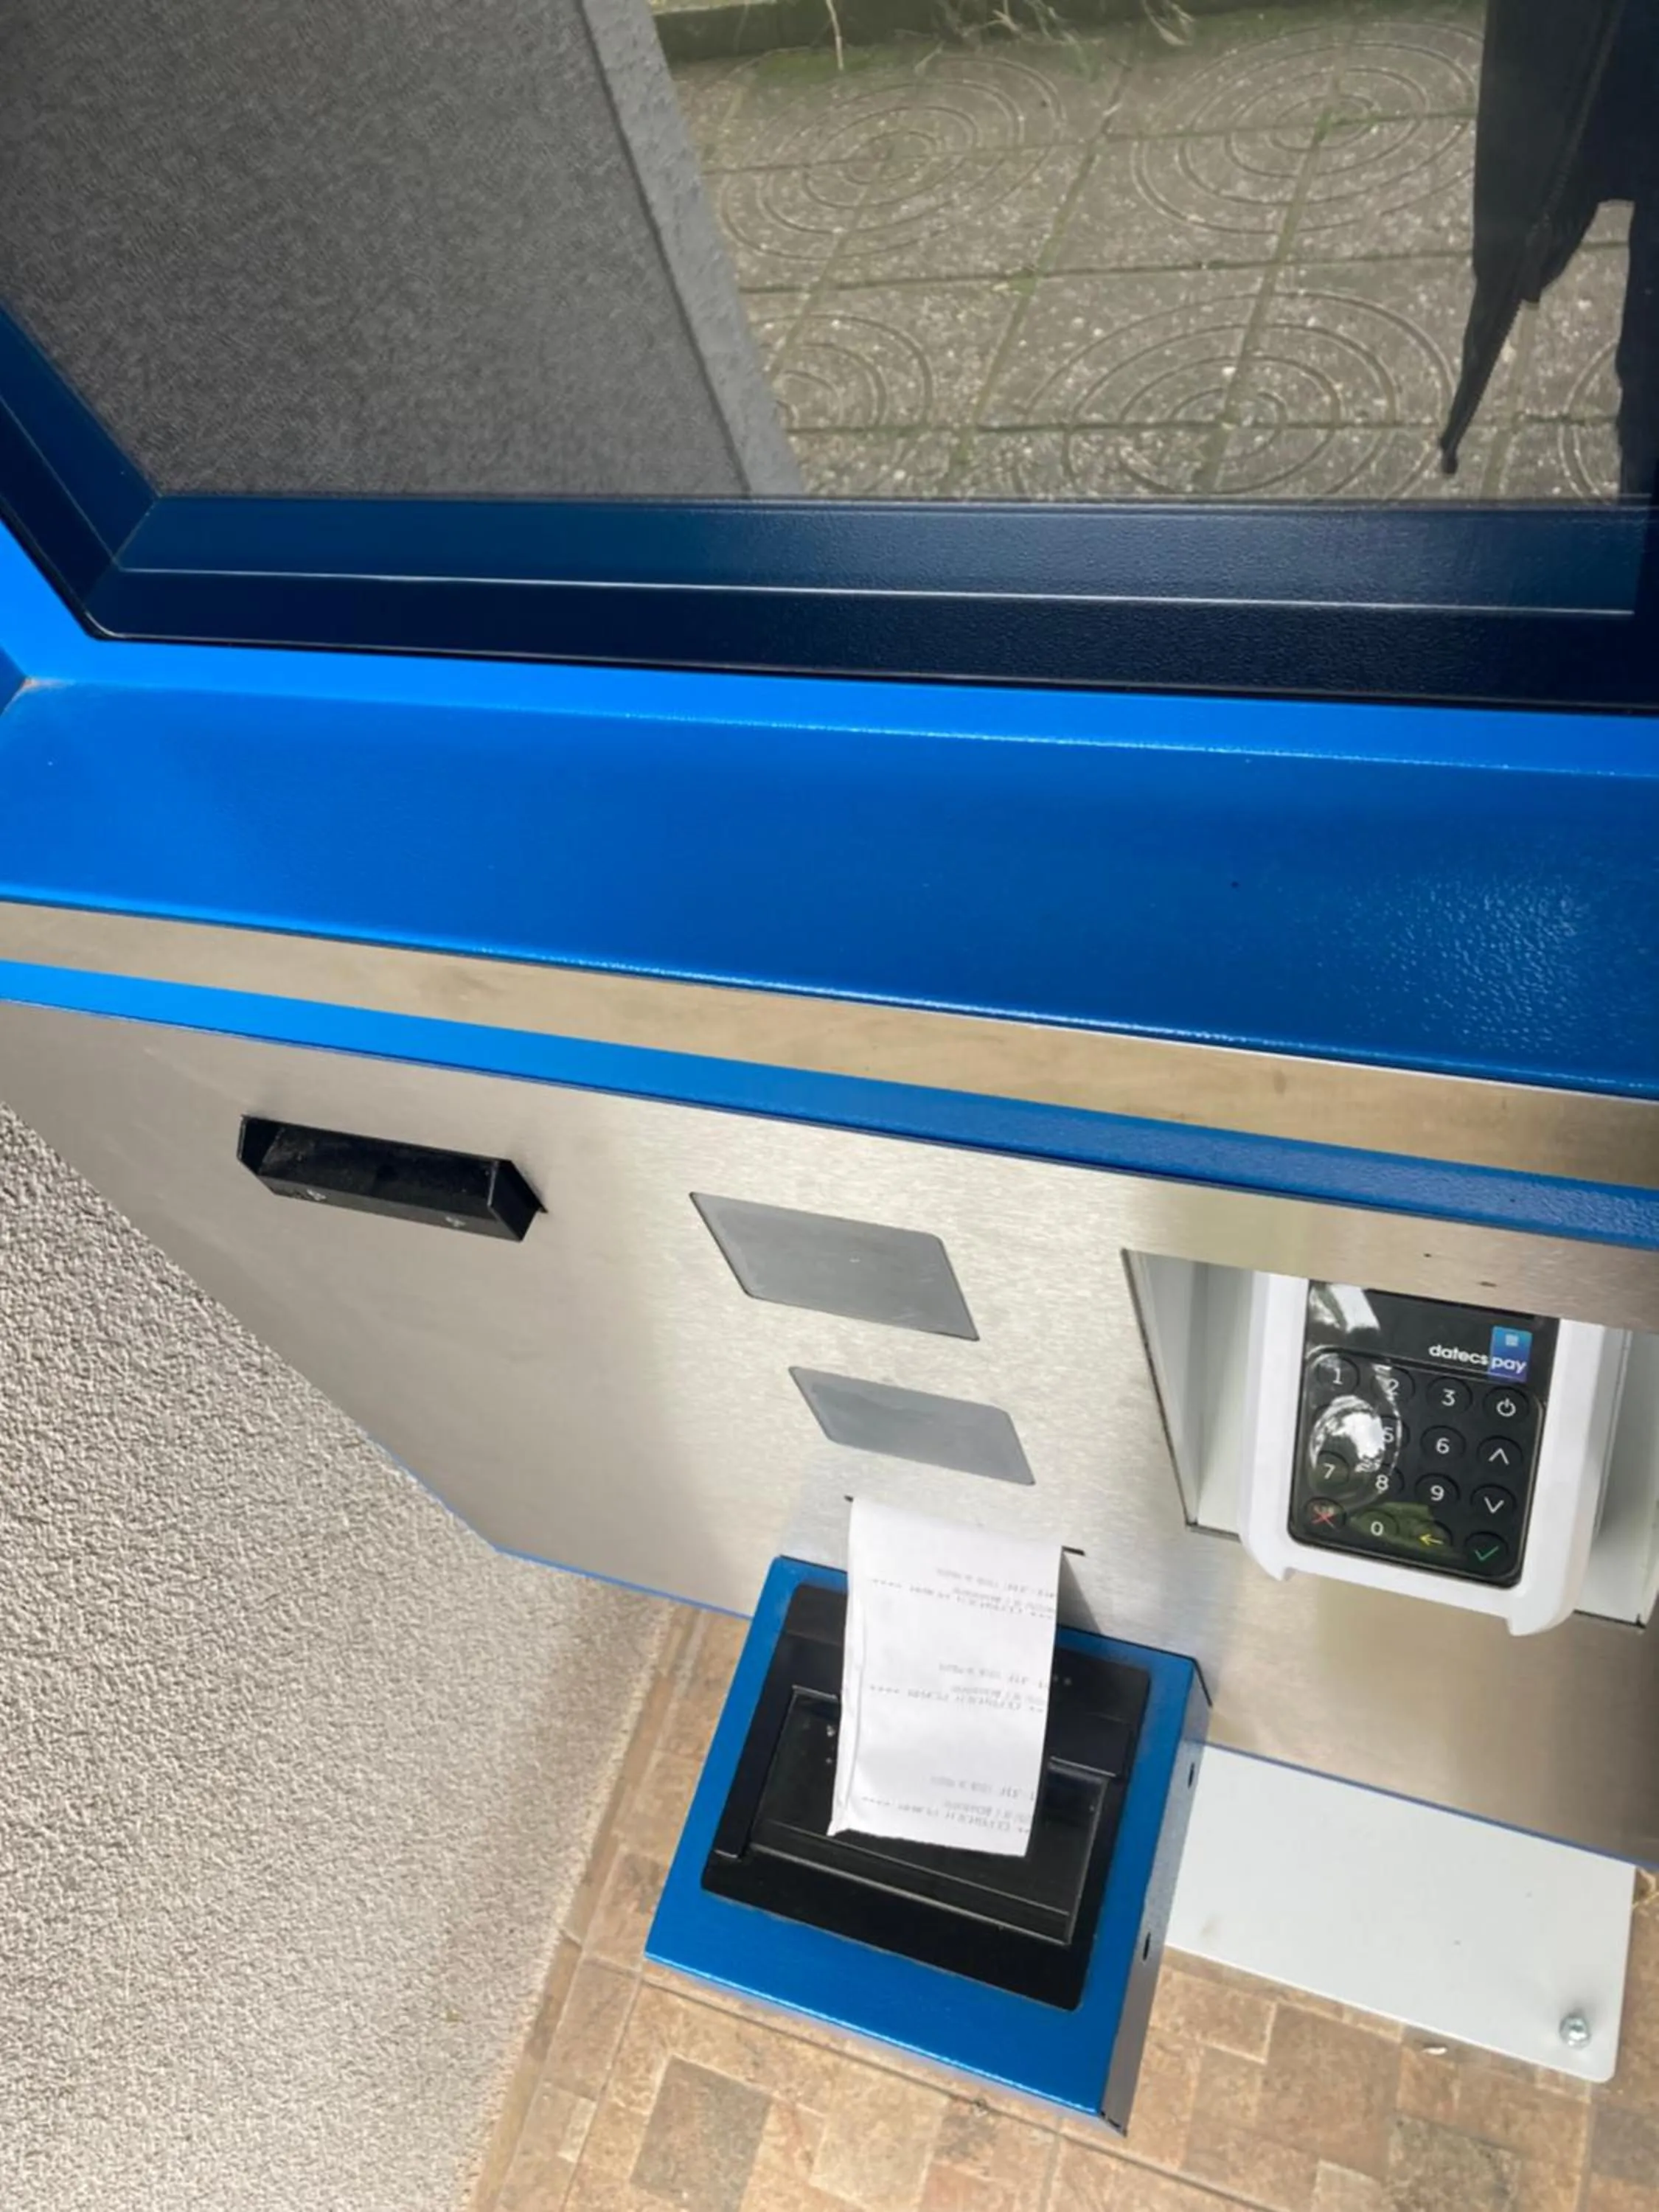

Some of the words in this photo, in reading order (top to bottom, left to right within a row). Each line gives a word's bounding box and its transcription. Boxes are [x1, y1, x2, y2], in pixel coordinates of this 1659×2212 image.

[1428, 1345, 1488, 1365] datecs
[1491, 1357, 1526, 1373] pay
[1334, 1367, 1343, 1385] 1
[1441, 1389, 1456, 1406] 3
[1436, 1437, 1450, 1454] 6
[1323, 1463, 1335, 1479] 7
[1375, 1474, 1389, 1491] 8
[1430, 1485, 1444, 1501] 9
